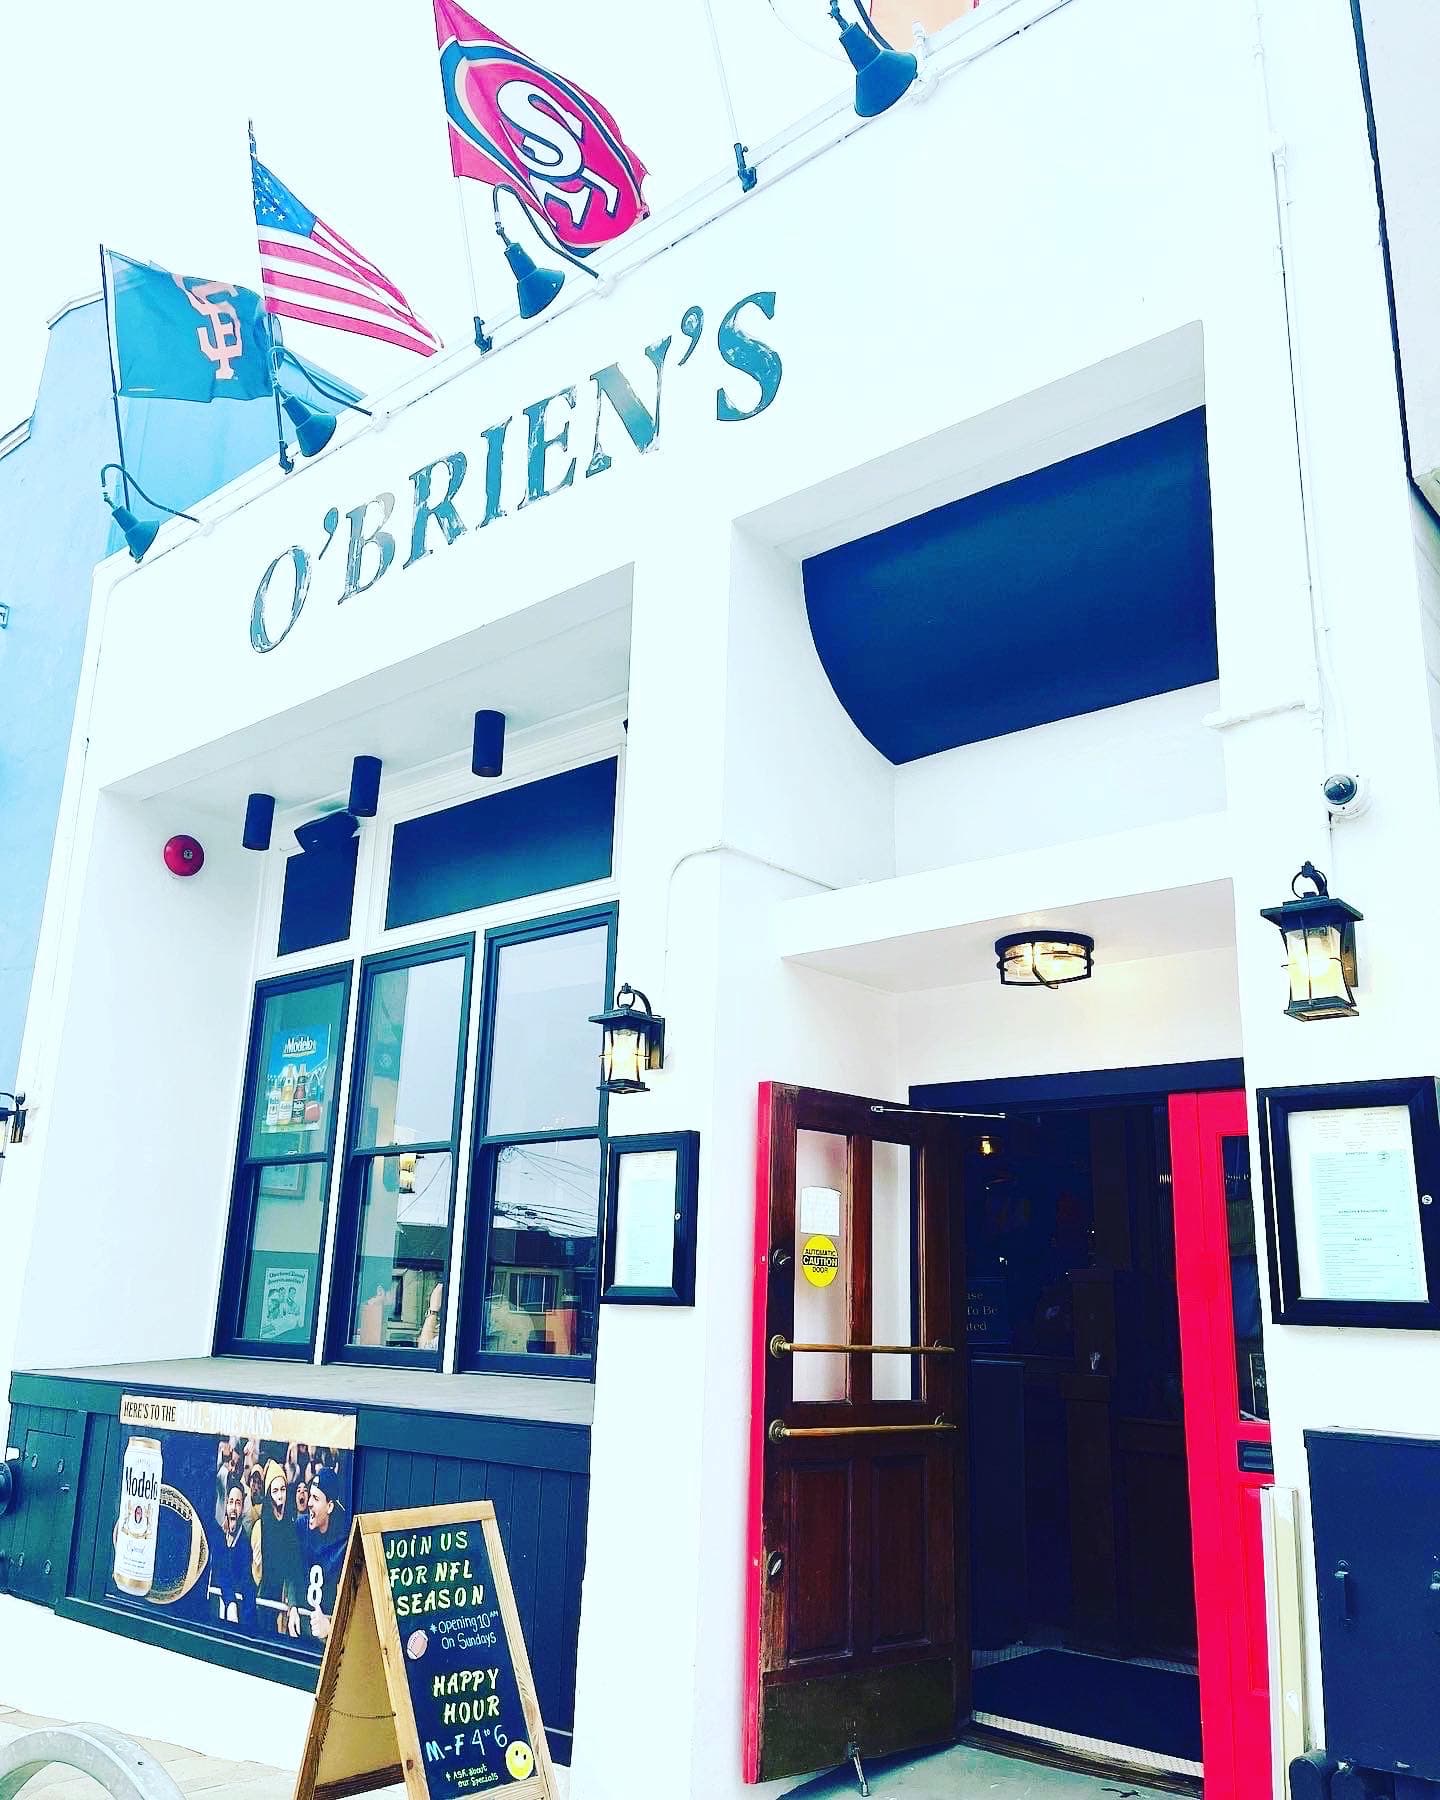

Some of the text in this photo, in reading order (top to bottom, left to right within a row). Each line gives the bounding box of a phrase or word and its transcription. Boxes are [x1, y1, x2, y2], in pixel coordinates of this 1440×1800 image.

[249, 291, 783, 654] O'BRIEN'S
[286, 1035, 315, 1053] Modelo
[803, 1256, 838, 1267] CAUTION
[804, 1248, 837, 1257] AUTOMATIC
[811, 1266, 829, 1274] DOOR
[983, 1304, 1001, 1316] Be
[123, 1401, 149, 1419] HERE'S
[150, 1404, 161, 1420] TO
[161, 1406, 177, 1423] THE
[125, 1466, 158, 1500] Modelo
[440, 1530, 469, 1551] US
[389, 1559, 473, 1588] FOR NFL
[306, 1564, 324, 1607] 8
[396, 1584, 484, 1616] SEASON
[438, 1616, 478, 1633] Opening
[441, 1631, 497, 1650] On Sundays
[432, 1668, 500, 1698] HAPPY
[443, 1695, 500, 1726] HOUR
[425, 1733, 465, 1763] M-F
[471, 1728, 486, 1756] 4
[493, 1724, 508, 1748] 6
[468, 1763, 488, 1776] about
